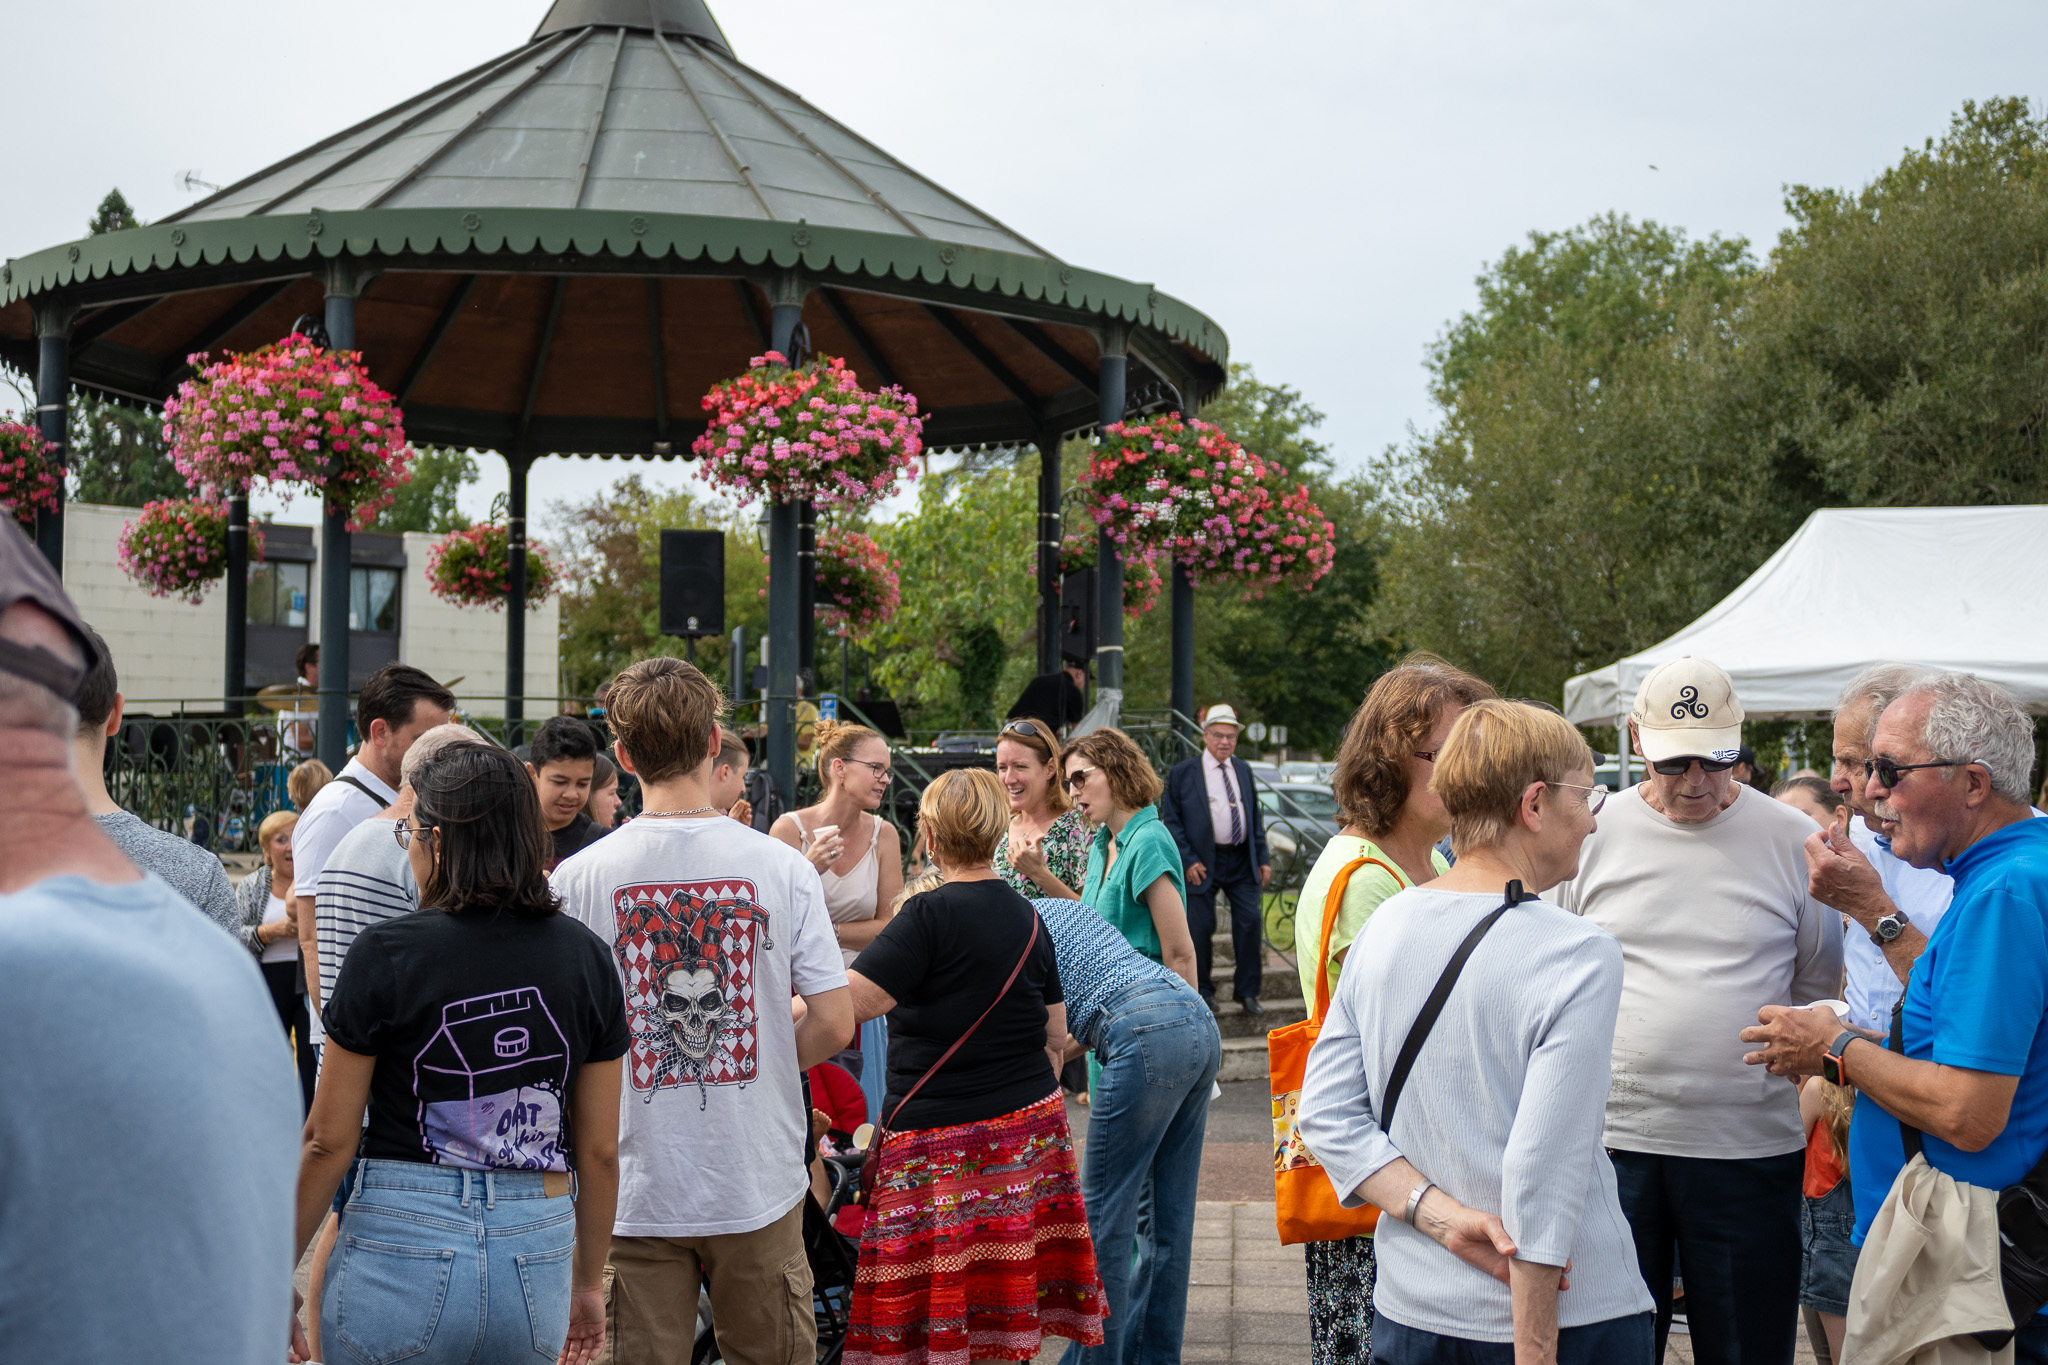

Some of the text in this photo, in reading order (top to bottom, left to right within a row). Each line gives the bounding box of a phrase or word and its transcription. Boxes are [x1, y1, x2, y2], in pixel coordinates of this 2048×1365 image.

[496, 1101, 543, 1136] OAT
[498, 1128, 550, 1163] of this
